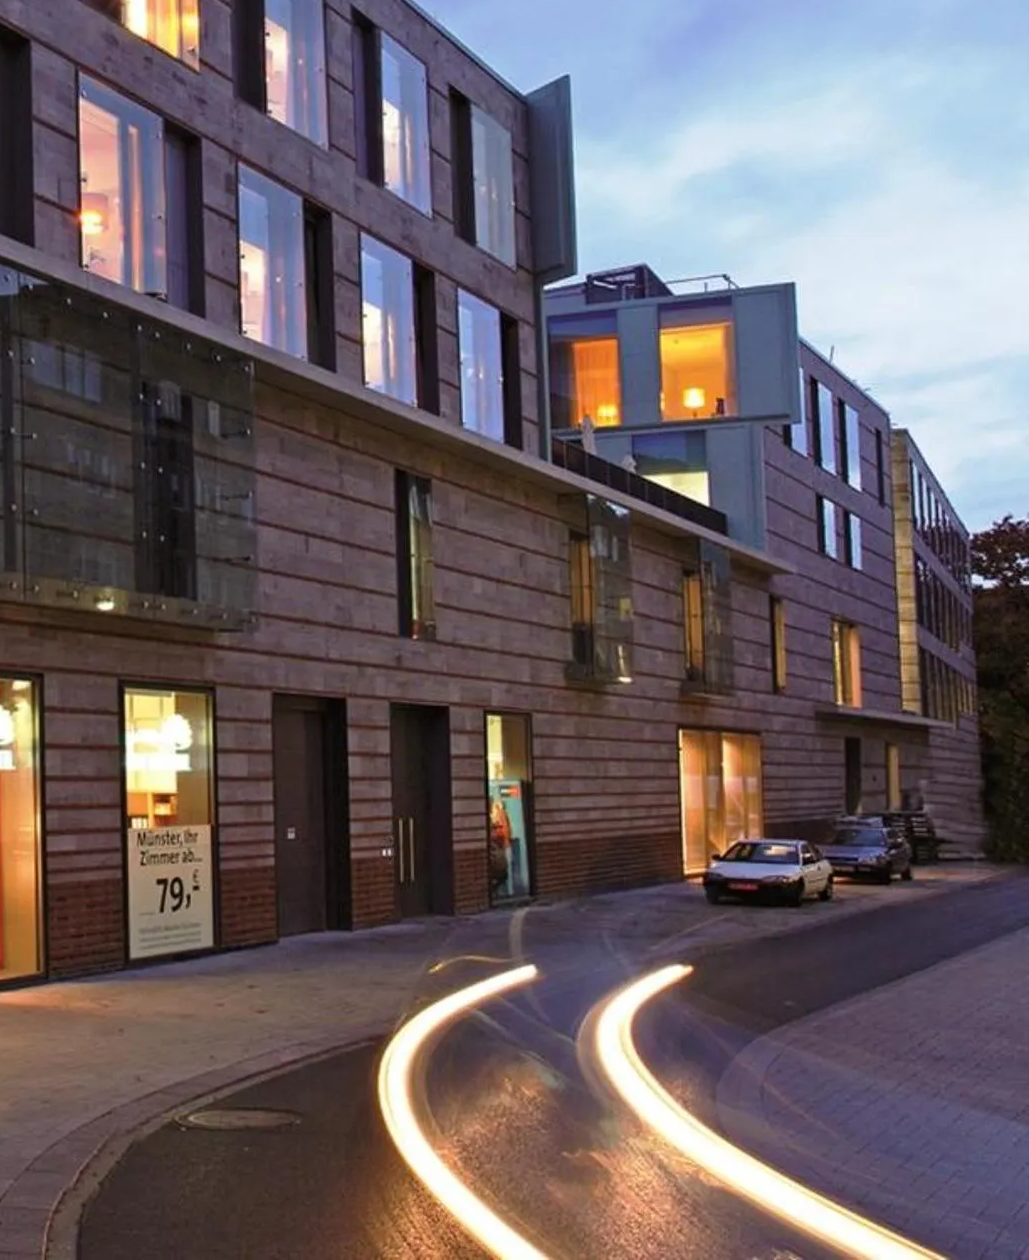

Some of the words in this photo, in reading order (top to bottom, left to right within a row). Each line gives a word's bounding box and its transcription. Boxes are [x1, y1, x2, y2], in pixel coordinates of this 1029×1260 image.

[137, 827, 183, 848] Münster,
[184, 826, 198, 843] Ihr
[140, 849, 179, 866] Zimmer
